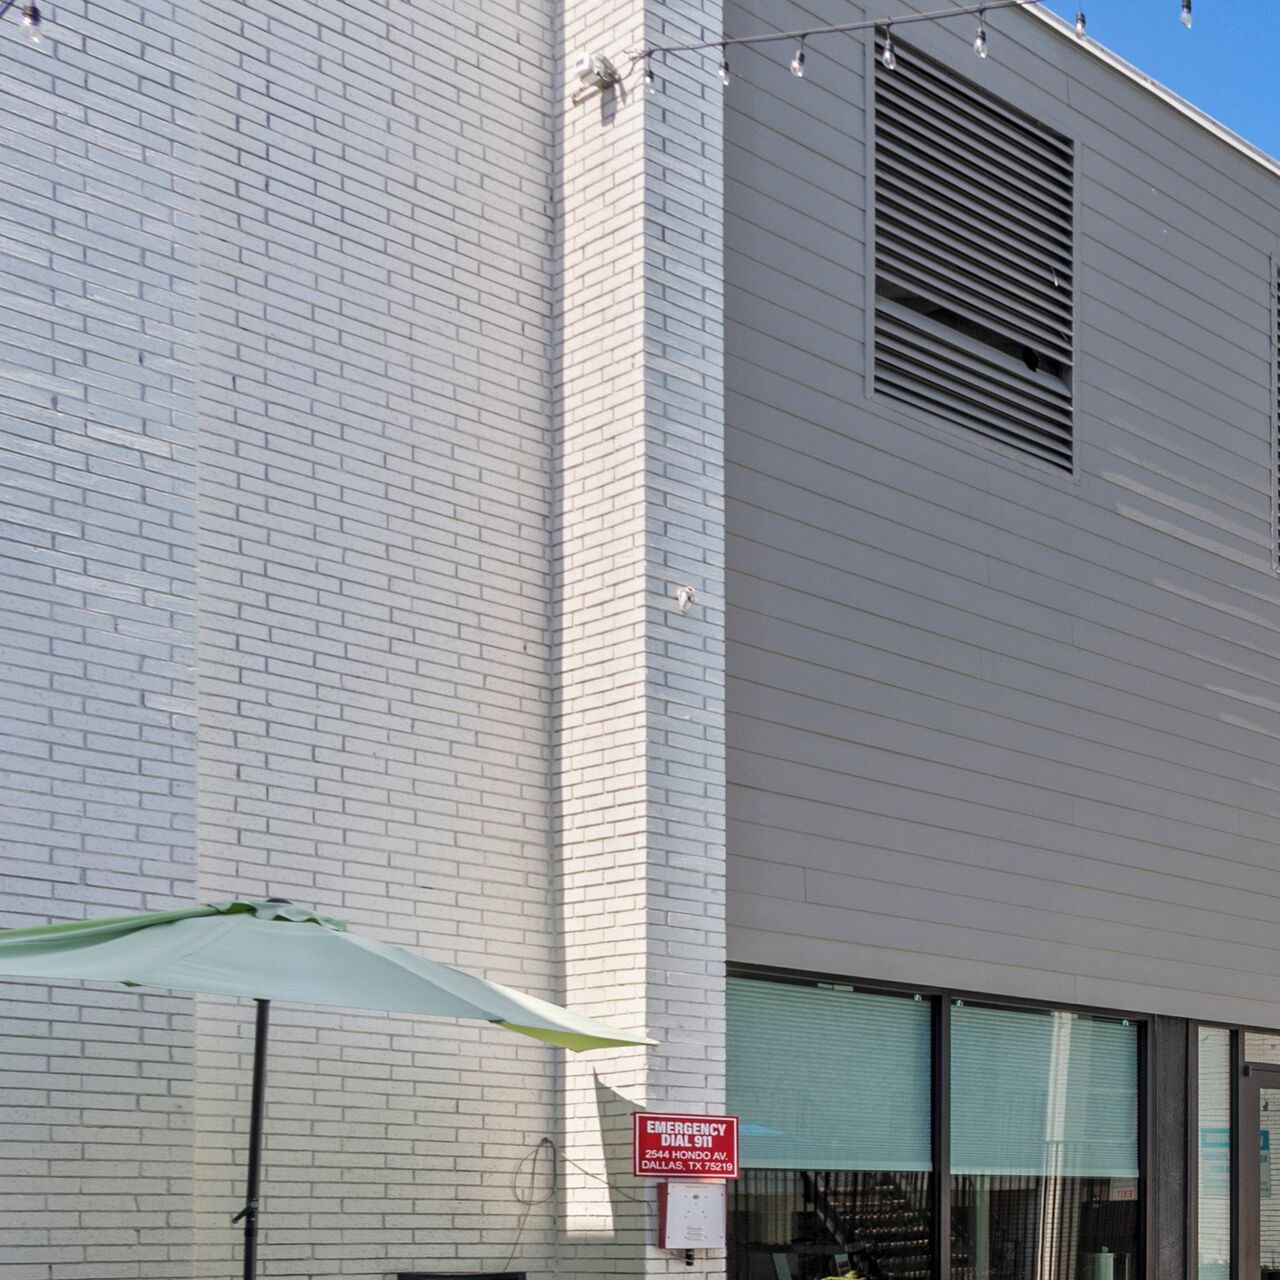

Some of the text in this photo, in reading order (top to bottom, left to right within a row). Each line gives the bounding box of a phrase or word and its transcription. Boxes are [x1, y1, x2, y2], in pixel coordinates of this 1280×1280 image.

[646, 1120, 726, 1136] EMERGENCY
[661, 1134, 713, 1148] DIAL 911
[645, 1149, 728, 1161] 2544 HONDO AV.
[641, 1161, 733, 1171] DALLAS, TX 75219
